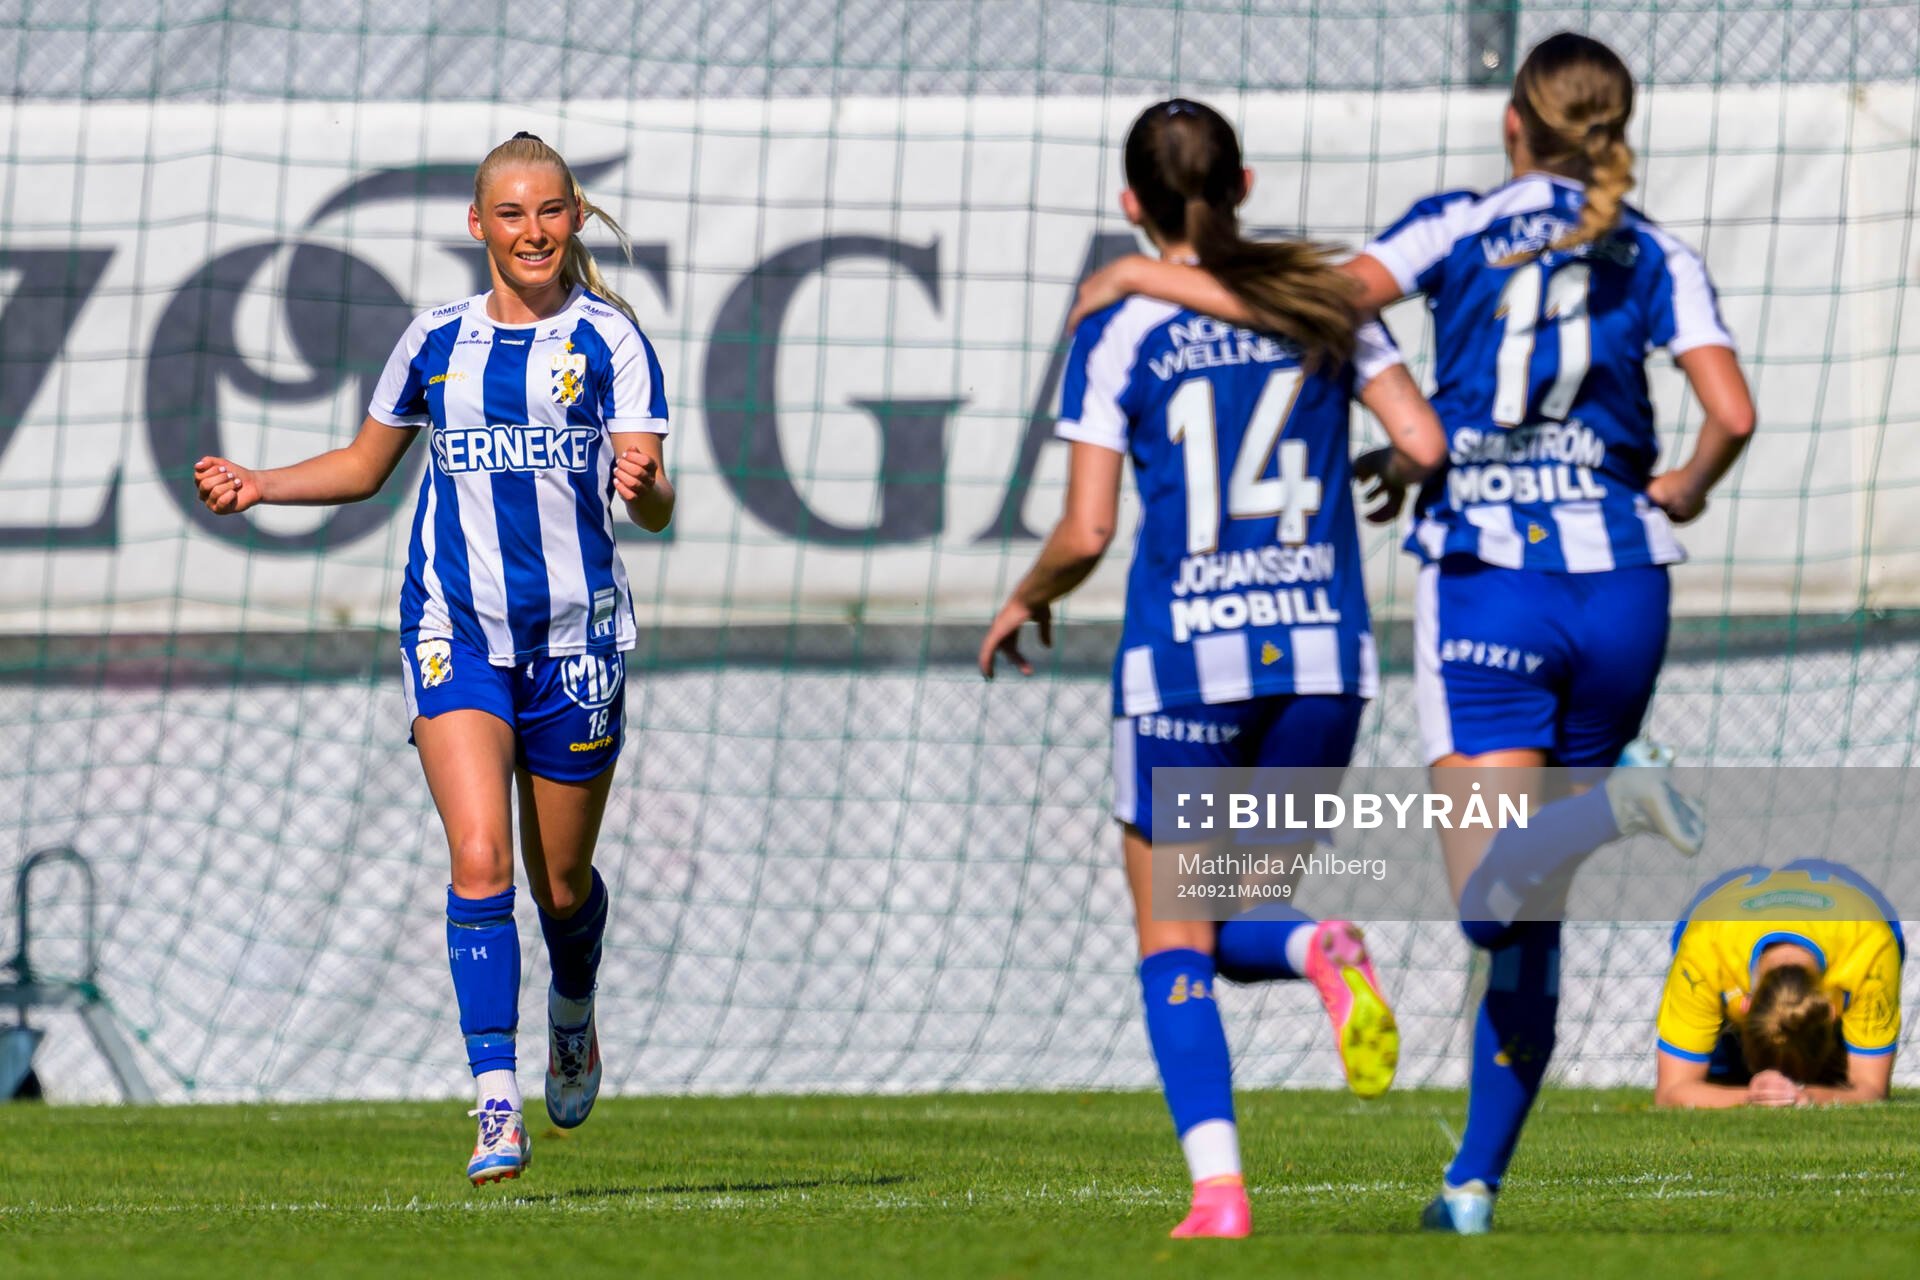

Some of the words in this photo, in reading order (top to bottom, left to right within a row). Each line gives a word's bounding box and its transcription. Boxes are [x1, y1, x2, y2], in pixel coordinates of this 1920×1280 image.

[432, 302, 470, 316] FAMECO
[1493, 262, 1592, 428] 11
[432, 425, 590, 475] SERNEKE
[1166, 366, 1322, 558] 14
[1447, 463, 1608, 512] MOBILL
[1172, 542, 1336, 597] JOHANSSON
[1170, 587, 1342, 643] MOBILL
[569, 738, 606, 753] CRAFT
[588, 708, 609, 740] 18
